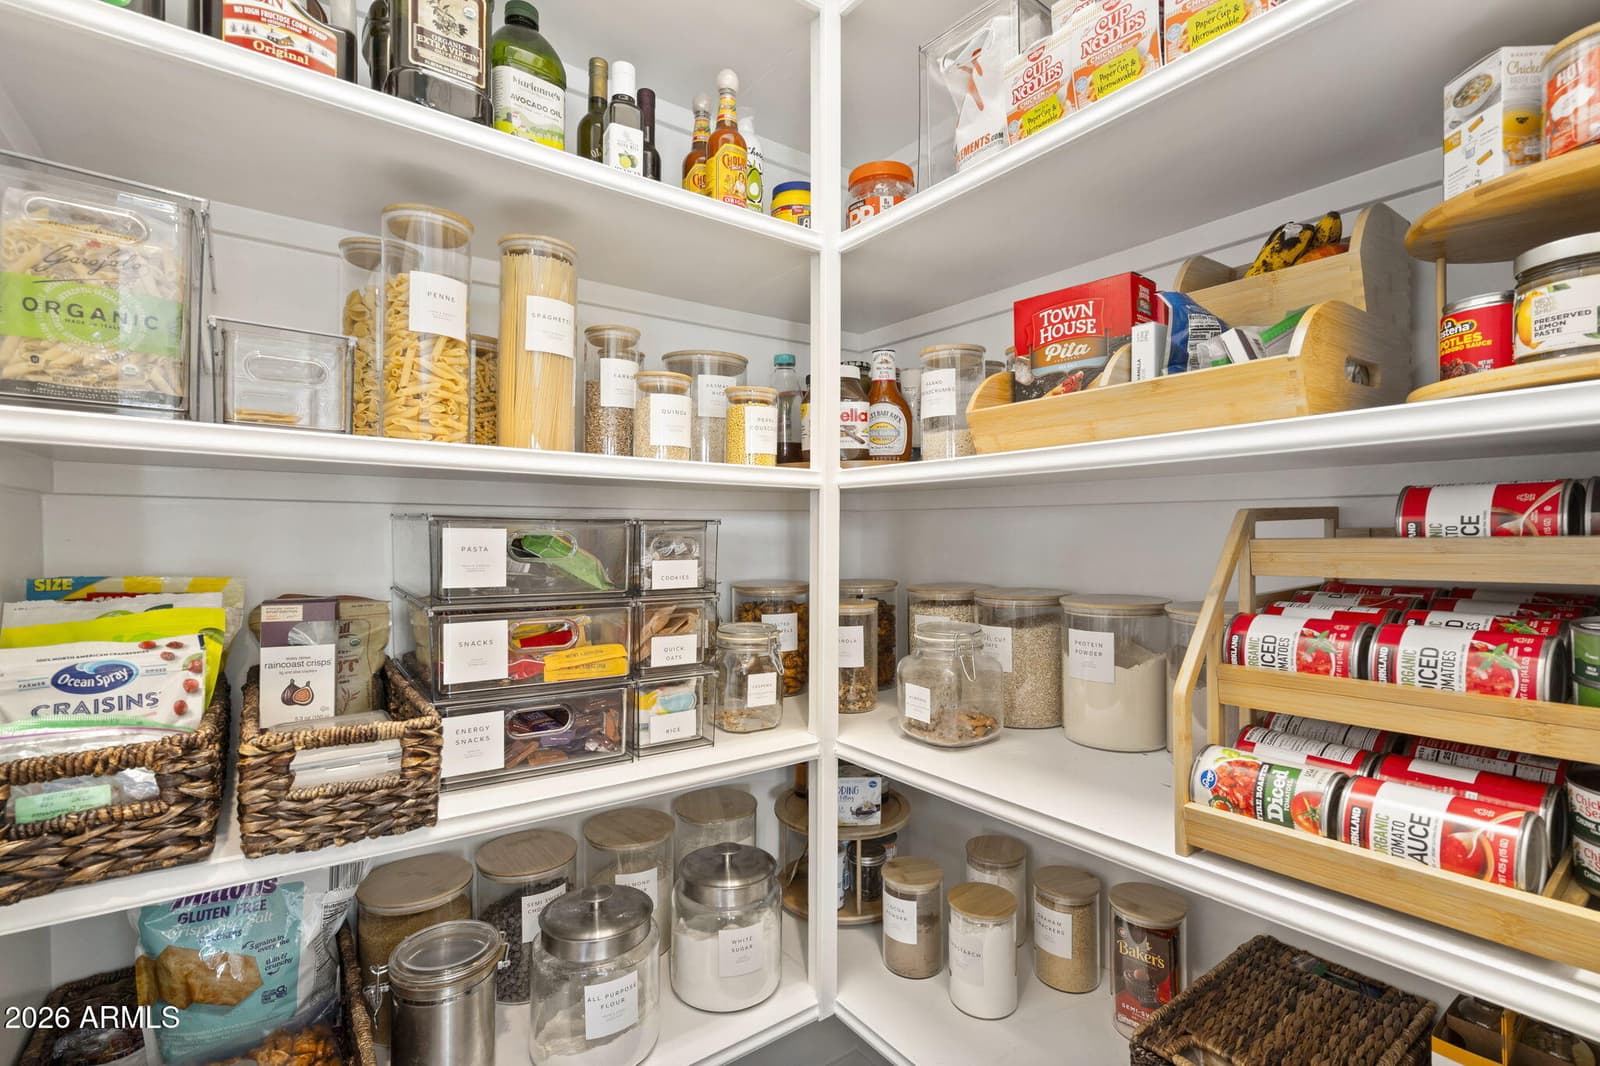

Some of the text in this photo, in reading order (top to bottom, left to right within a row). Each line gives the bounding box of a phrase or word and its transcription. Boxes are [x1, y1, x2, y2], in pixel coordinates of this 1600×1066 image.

[1094, 3, 1132, 36] CUP
[1195, 4, 1240, 30] Paper Cup &
[1080, 10, 1146, 60] NOODLES
[1192, 16, 1240, 46] Microwavable
[252, 40, 310, 66] Original
[416, 34, 480, 63] EXTRA VIRGIN
[431, 34, 468, 51] ORGANIC
[1022, 55, 1052, 84] CUP
[1099, 58, 1136, 82] Paper Cup &
[1012, 61, 1064, 106] NOODLES
[1097, 69, 1137, 96] Microwavable
[510, 92, 562, 120] AVOCADO OIL
[1028, 113, 1042, 126] Paper
[32, 244, 142, 276] Garofalo
[427, 291, 456, 303] PENNE
[22, 296, 160, 330] ORGANIC
[1040, 301, 1094, 328] TOWN
[1534, 309, 1592, 326] PRESERVED
[1040, 318, 1096, 345] HOUSE
[1534, 320, 1567, 332] LEMON
[1534, 328, 1562, 338] PASTE
[1045, 342, 1092, 362] Pita
[1466, 340, 1492, 349] SAUCE
[840, 408, 868, 422] ella
[34, 578, 74, 592] SIZE
[458, 640, 494, 648] SNACKS
[1074, 640, 1103, 648] PROTEIN
[1074, 648, 1103, 656] POWDER
[1248, 636, 1260, 666] RGANIC
[1261, 634, 1277, 668] ICED
[1278, 637, 1290, 670] MATOES
[264, 658, 304, 670] raincoast
[306, 658, 332, 668] crisps
[19, 681, 46, 689] FARMER
[58, 668, 129, 690] Ocean Spray
[30, 692, 160, 717] CRAISINS
[455, 736, 491, 746] SNACKS
[456, 725, 490, 736] ENERGY
[1267, 769, 1290, 822] Diced
[1408, 812, 1431, 865] AUCE
[177, 899, 267, 924] GLUTEN FREE
[248, 912, 273, 926] Salt
[1036, 912, 1062, 928] GRAHAM
[732, 936, 752, 945] WHITE
[732, 944, 752, 952] SUGAR
[1116, 940, 1166, 970] Baker's
[604, 983, 637, 1000] PURPOSE
[600, 998, 626, 1010] FLOUR
